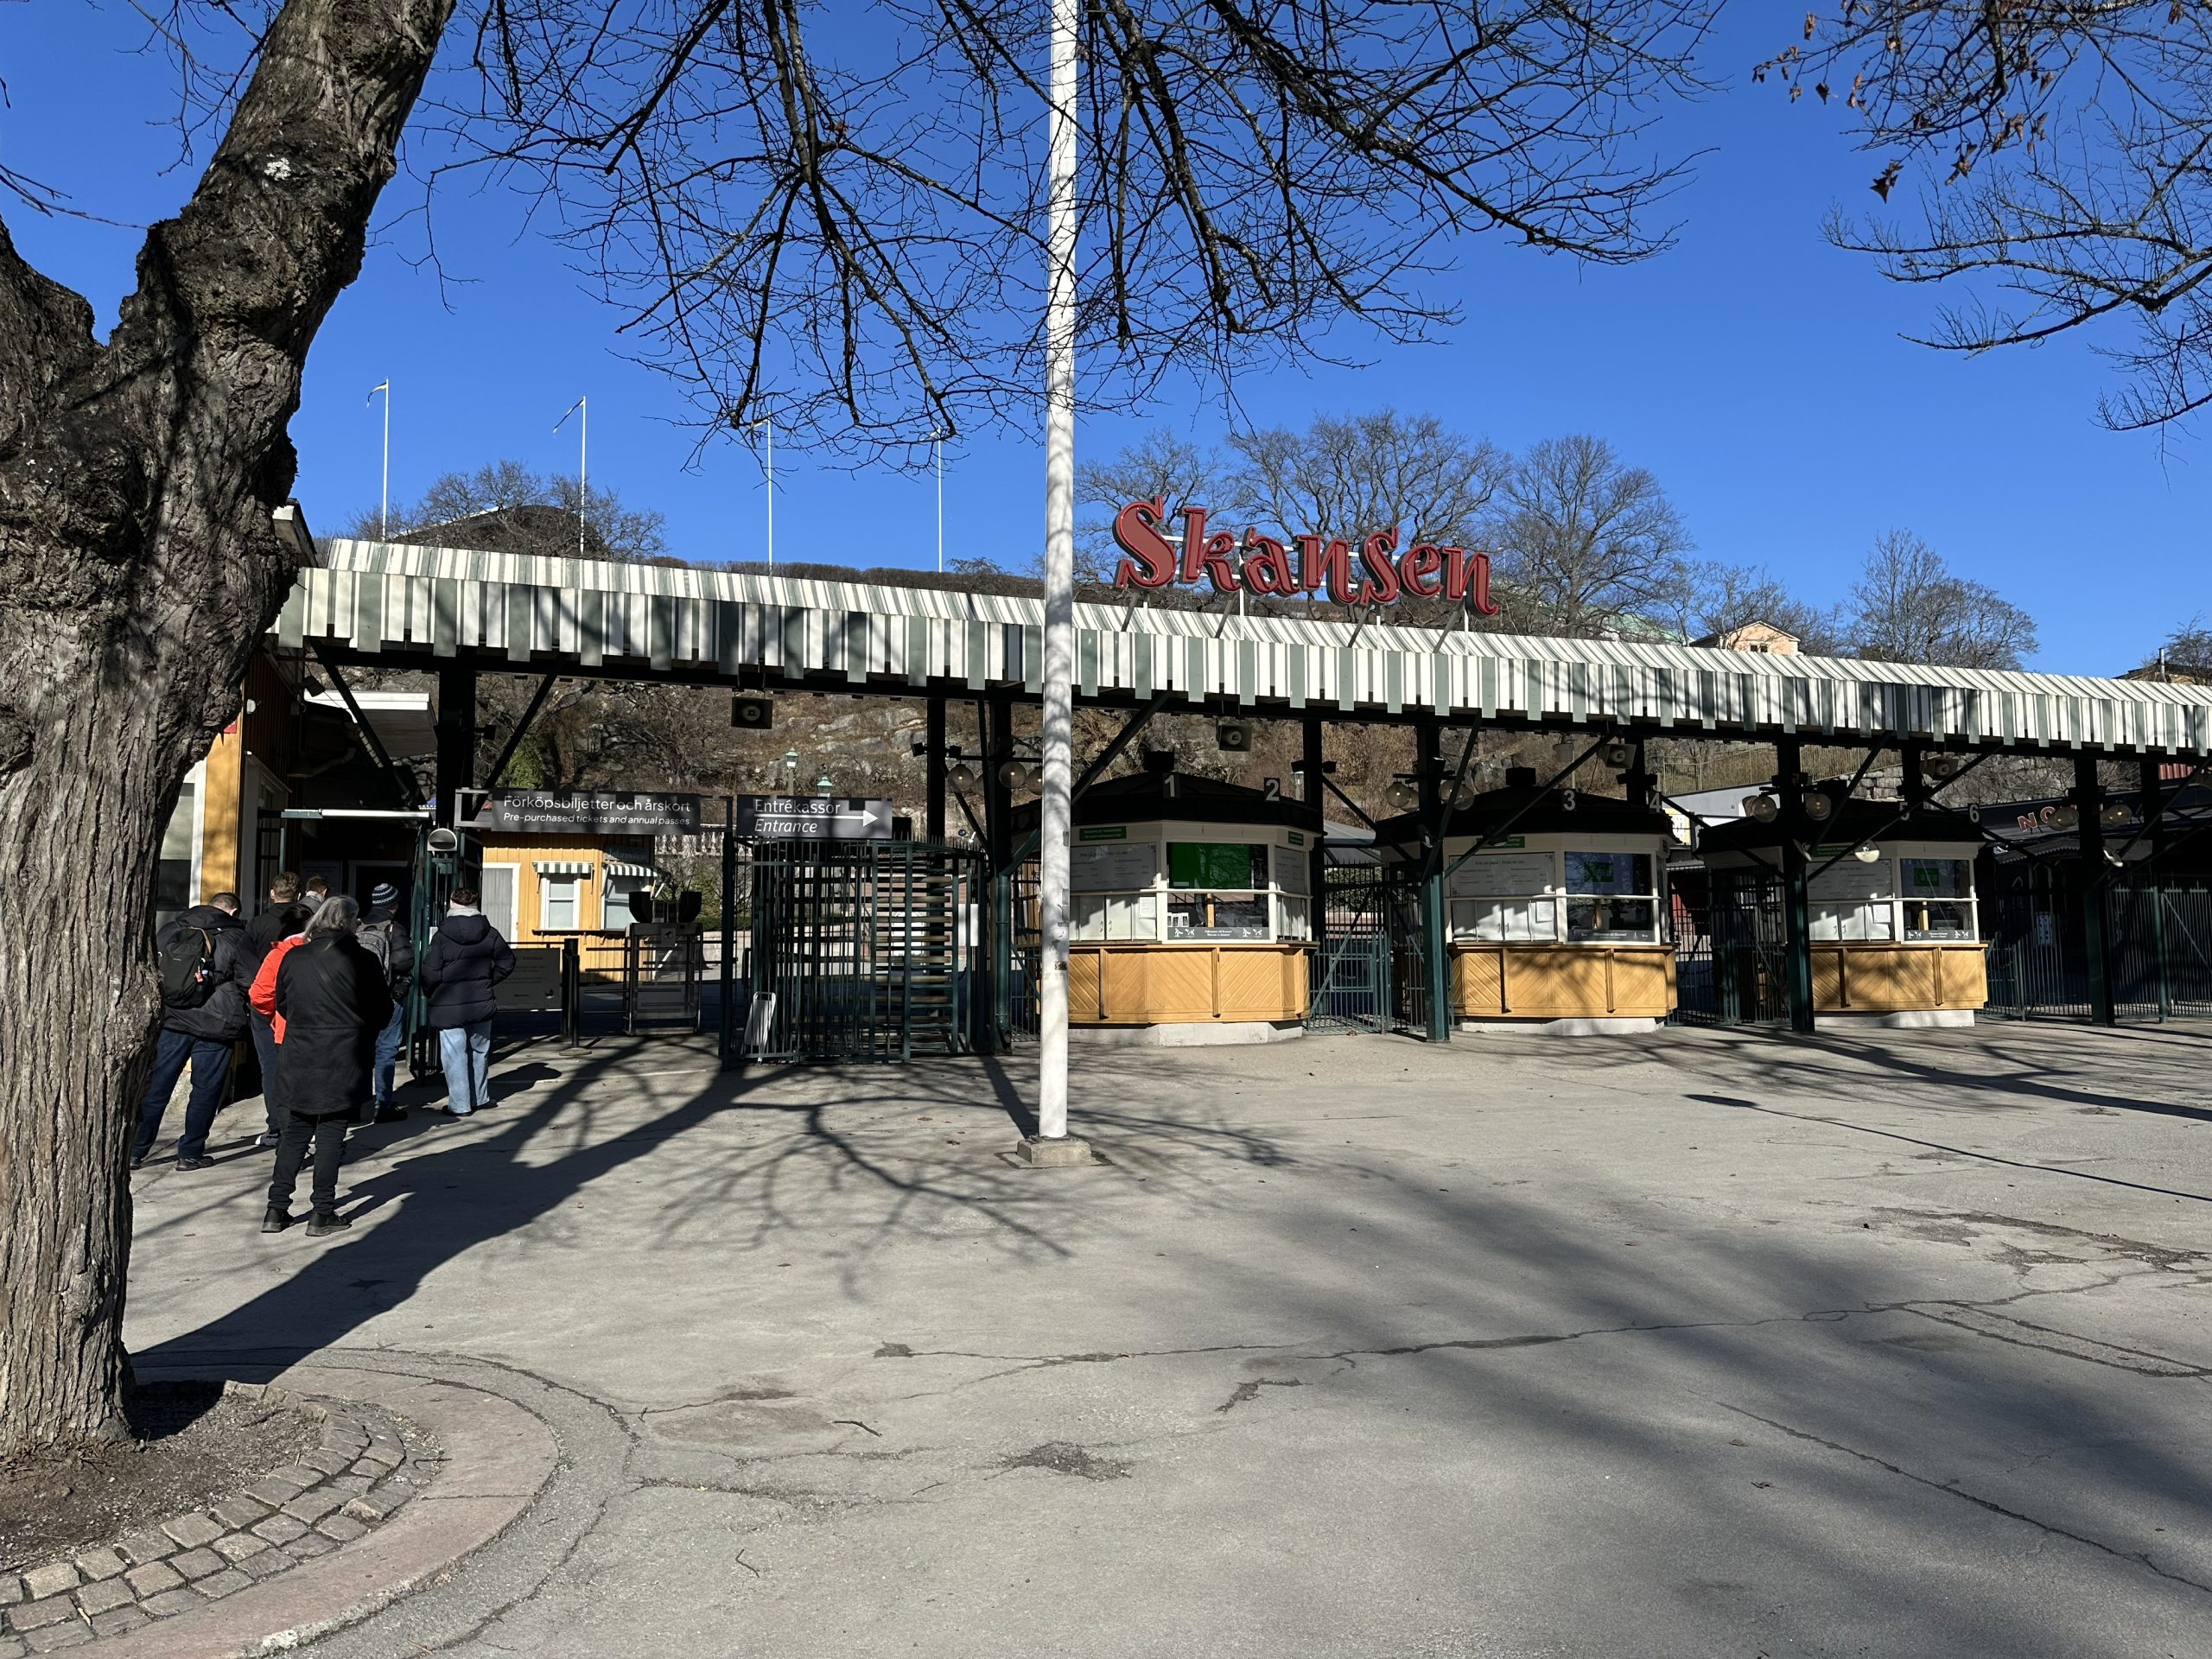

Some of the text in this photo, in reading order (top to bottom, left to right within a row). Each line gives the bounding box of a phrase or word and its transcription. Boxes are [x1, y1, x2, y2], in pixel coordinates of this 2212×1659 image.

[1112, 495, 1499, 617] Skansen
[1164, 774, 1175, 797] 1
[1266, 779, 1280, 801] 2
[504, 795, 690, 812] Förköpsbiljetter och årskort
[754, 798, 841, 815] Entrékassor
[1563, 789, 1576, 810] 3
[1649, 792, 1662, 813] 4
[504, 812, 690, 826] Pre-purchased tickets and annual passes
[1969, 804, 1980, 823] 6
[754, 818, 817, 833] Entrance
